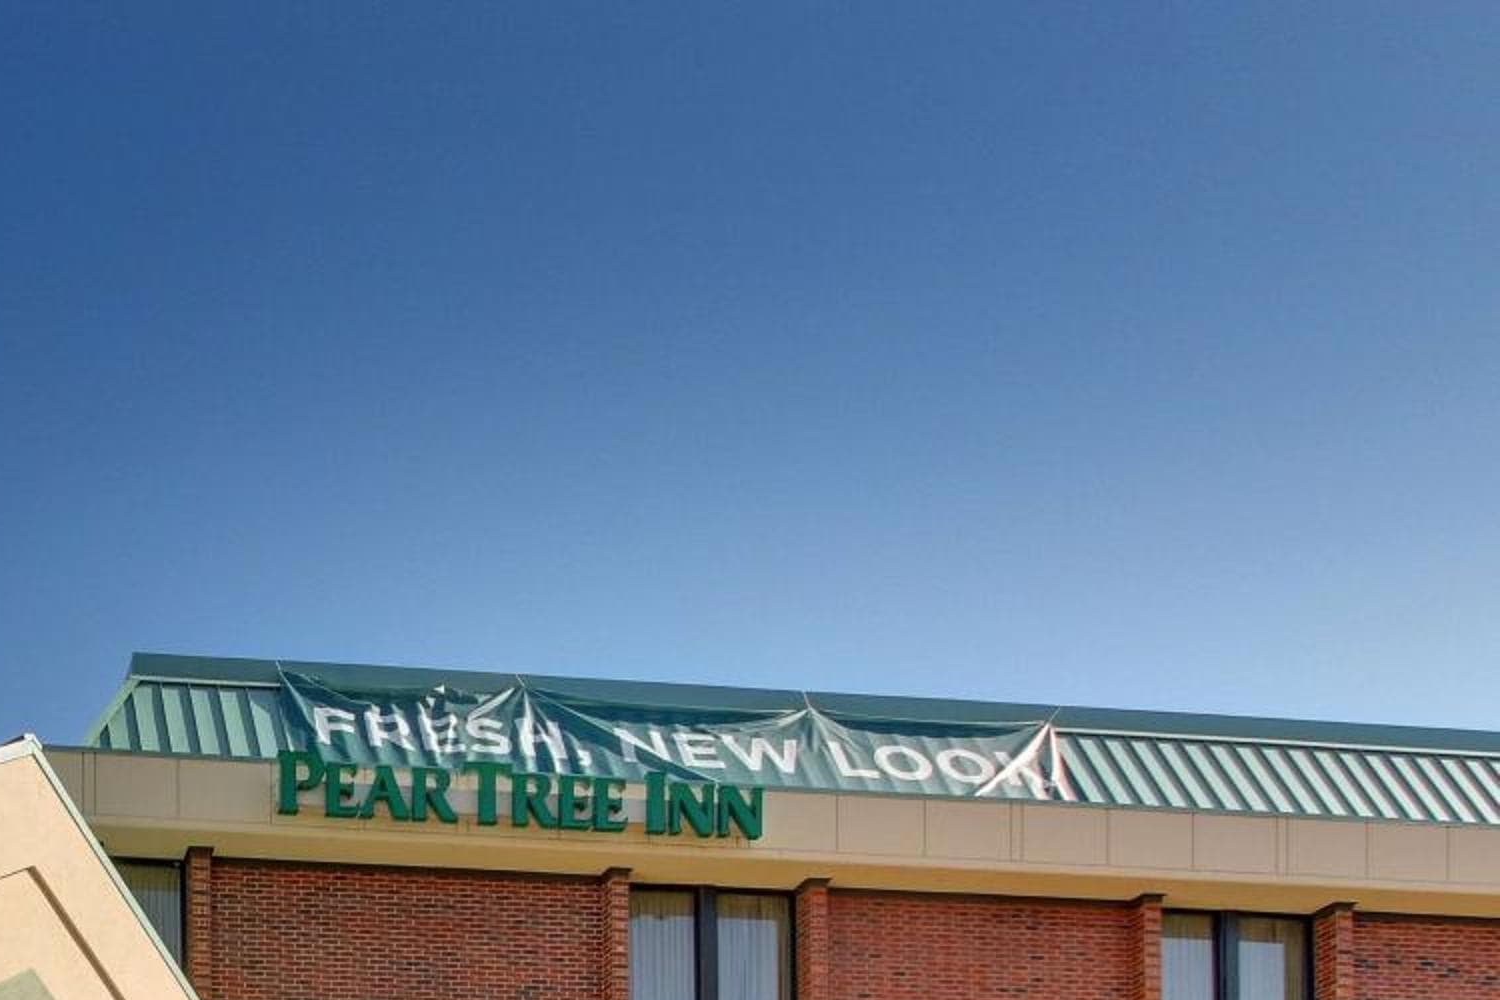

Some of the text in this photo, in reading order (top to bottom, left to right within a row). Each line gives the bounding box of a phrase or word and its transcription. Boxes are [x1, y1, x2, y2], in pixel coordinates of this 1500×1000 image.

[612, 726, 797, 774] NEW
[278, 750, 764, 841] PEAR TREE INN
